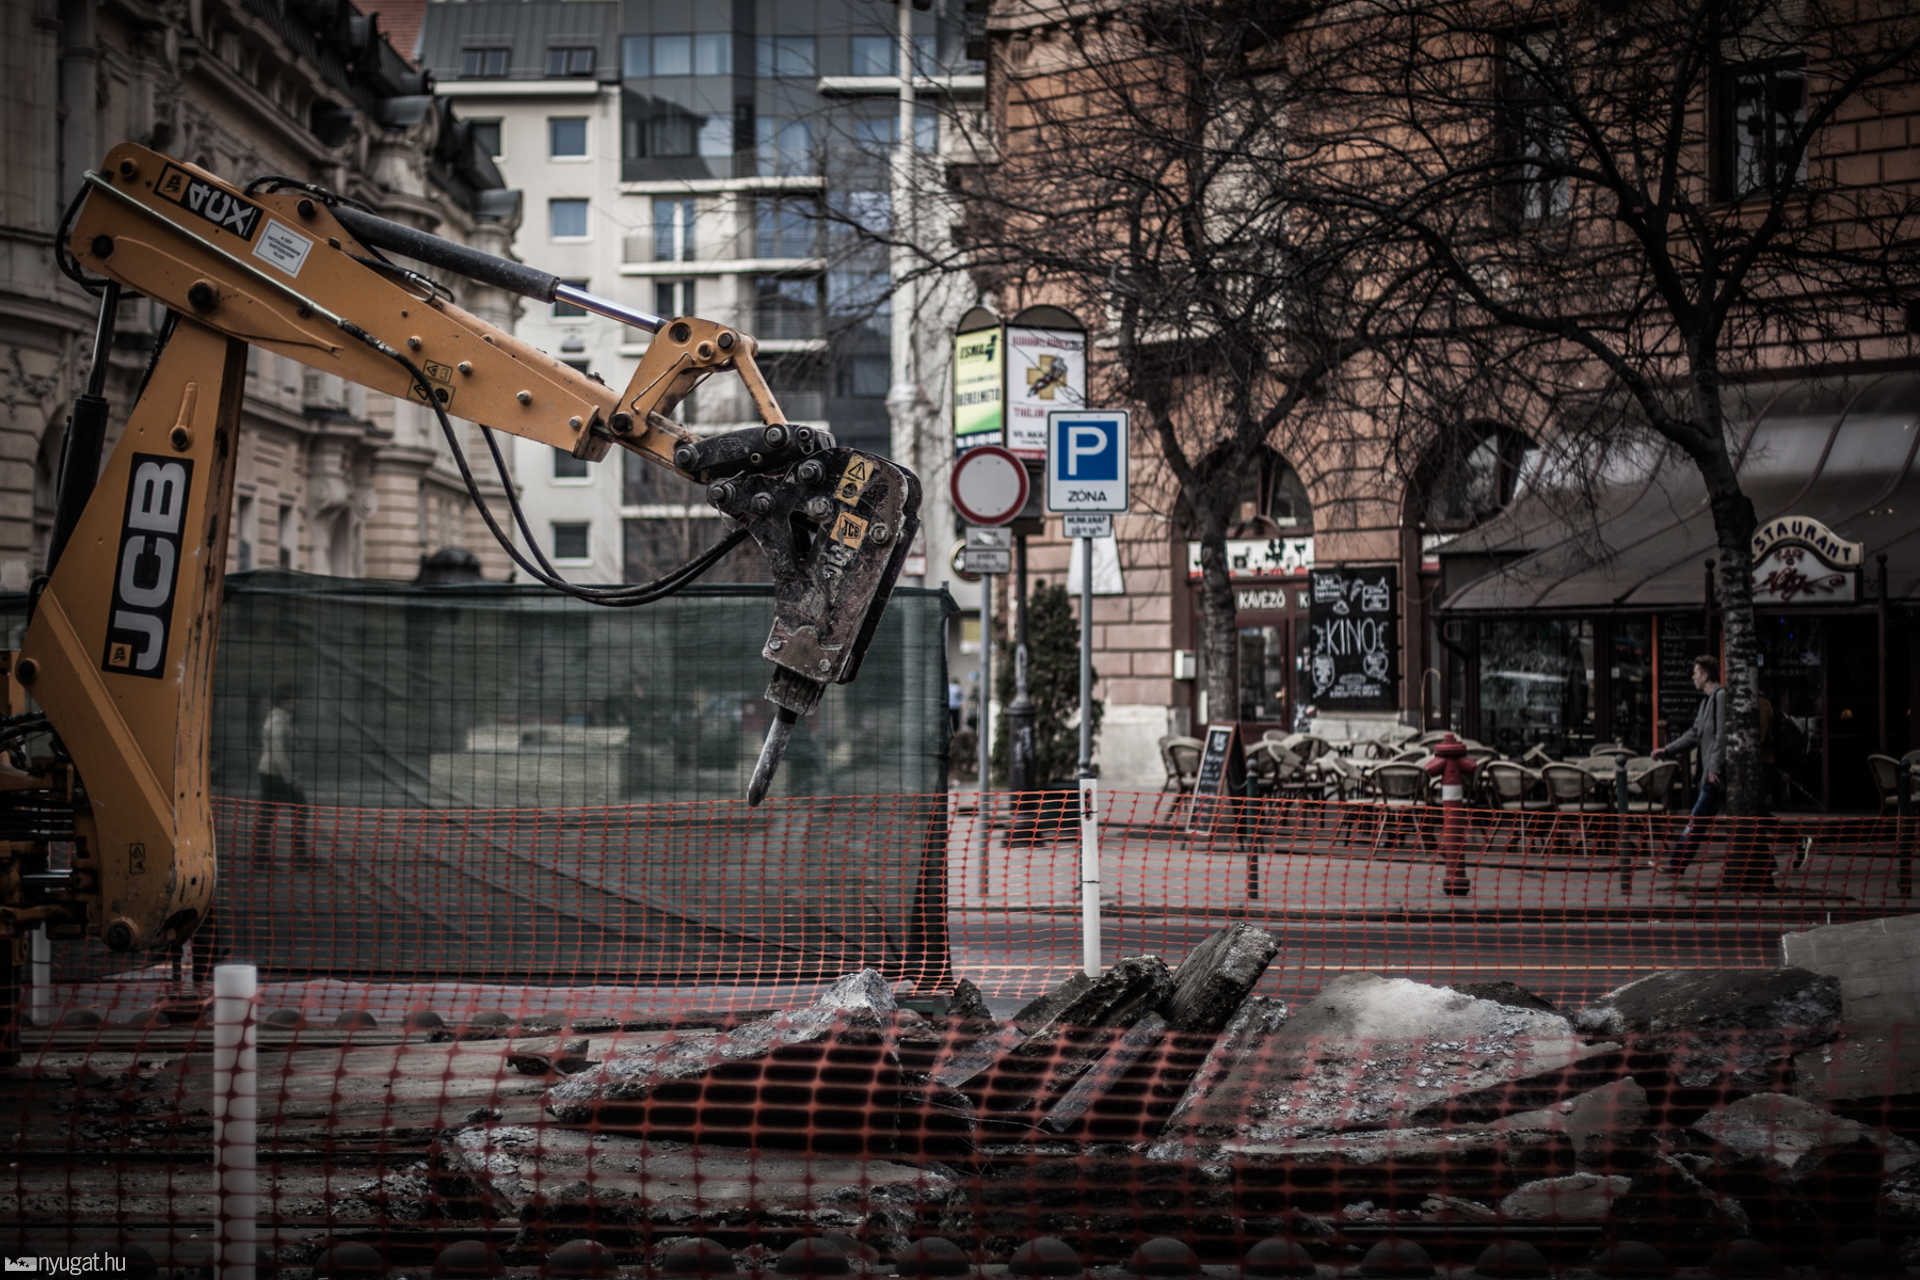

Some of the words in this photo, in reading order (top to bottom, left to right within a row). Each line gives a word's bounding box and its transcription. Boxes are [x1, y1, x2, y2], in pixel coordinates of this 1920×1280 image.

[1067, 426, 1108, 476] P
[1068, 489, 1108, 502] ZÓNA
[842, 519, 861, 539] JCB
[1752, 520, 1852, 561] STAURANT
[113, 462, 186, 671] JCB
[1326, 617, 1377, 656] KINO
